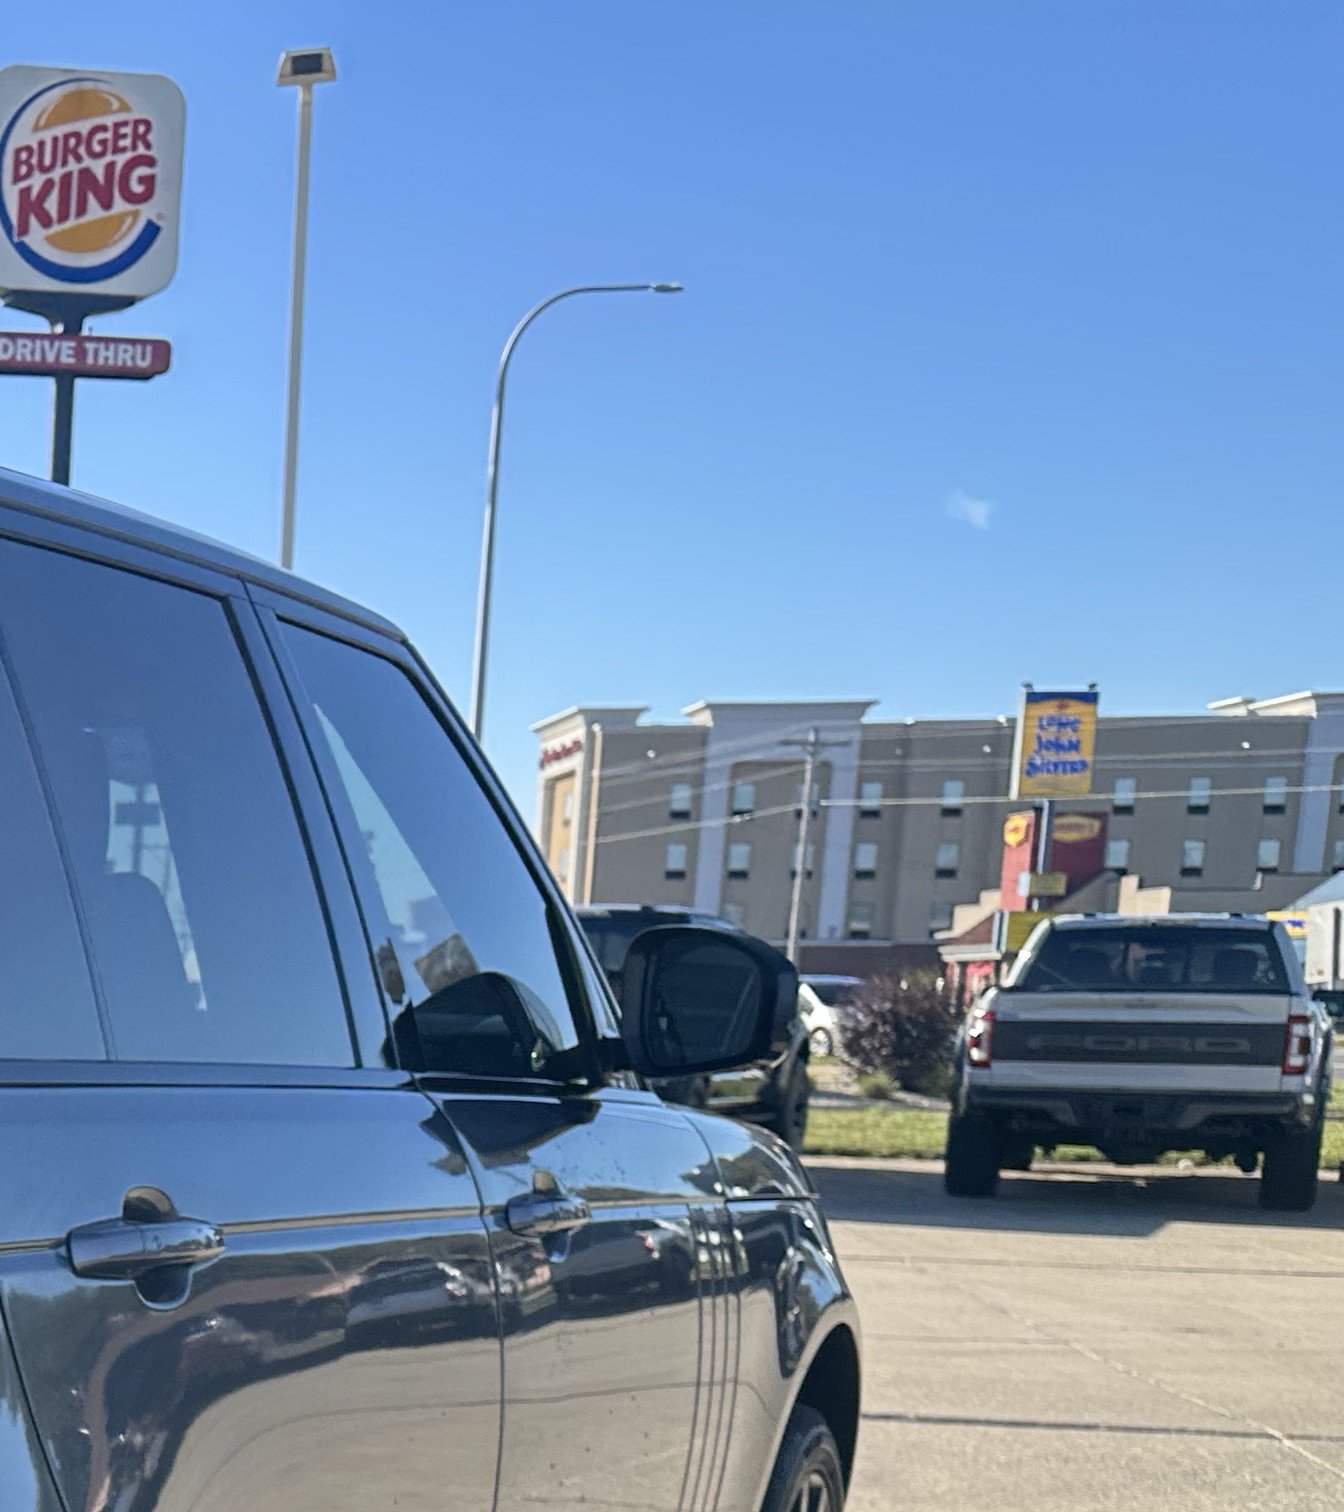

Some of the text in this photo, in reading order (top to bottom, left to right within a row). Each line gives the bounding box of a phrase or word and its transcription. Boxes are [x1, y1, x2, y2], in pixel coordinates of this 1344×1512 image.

[12, 117, 152, 185] BURGER
[16, 154, 157, 241] KING
[84, 344, 152, 368] THRU
[1028, 1033, 1252, 1054] FORD
